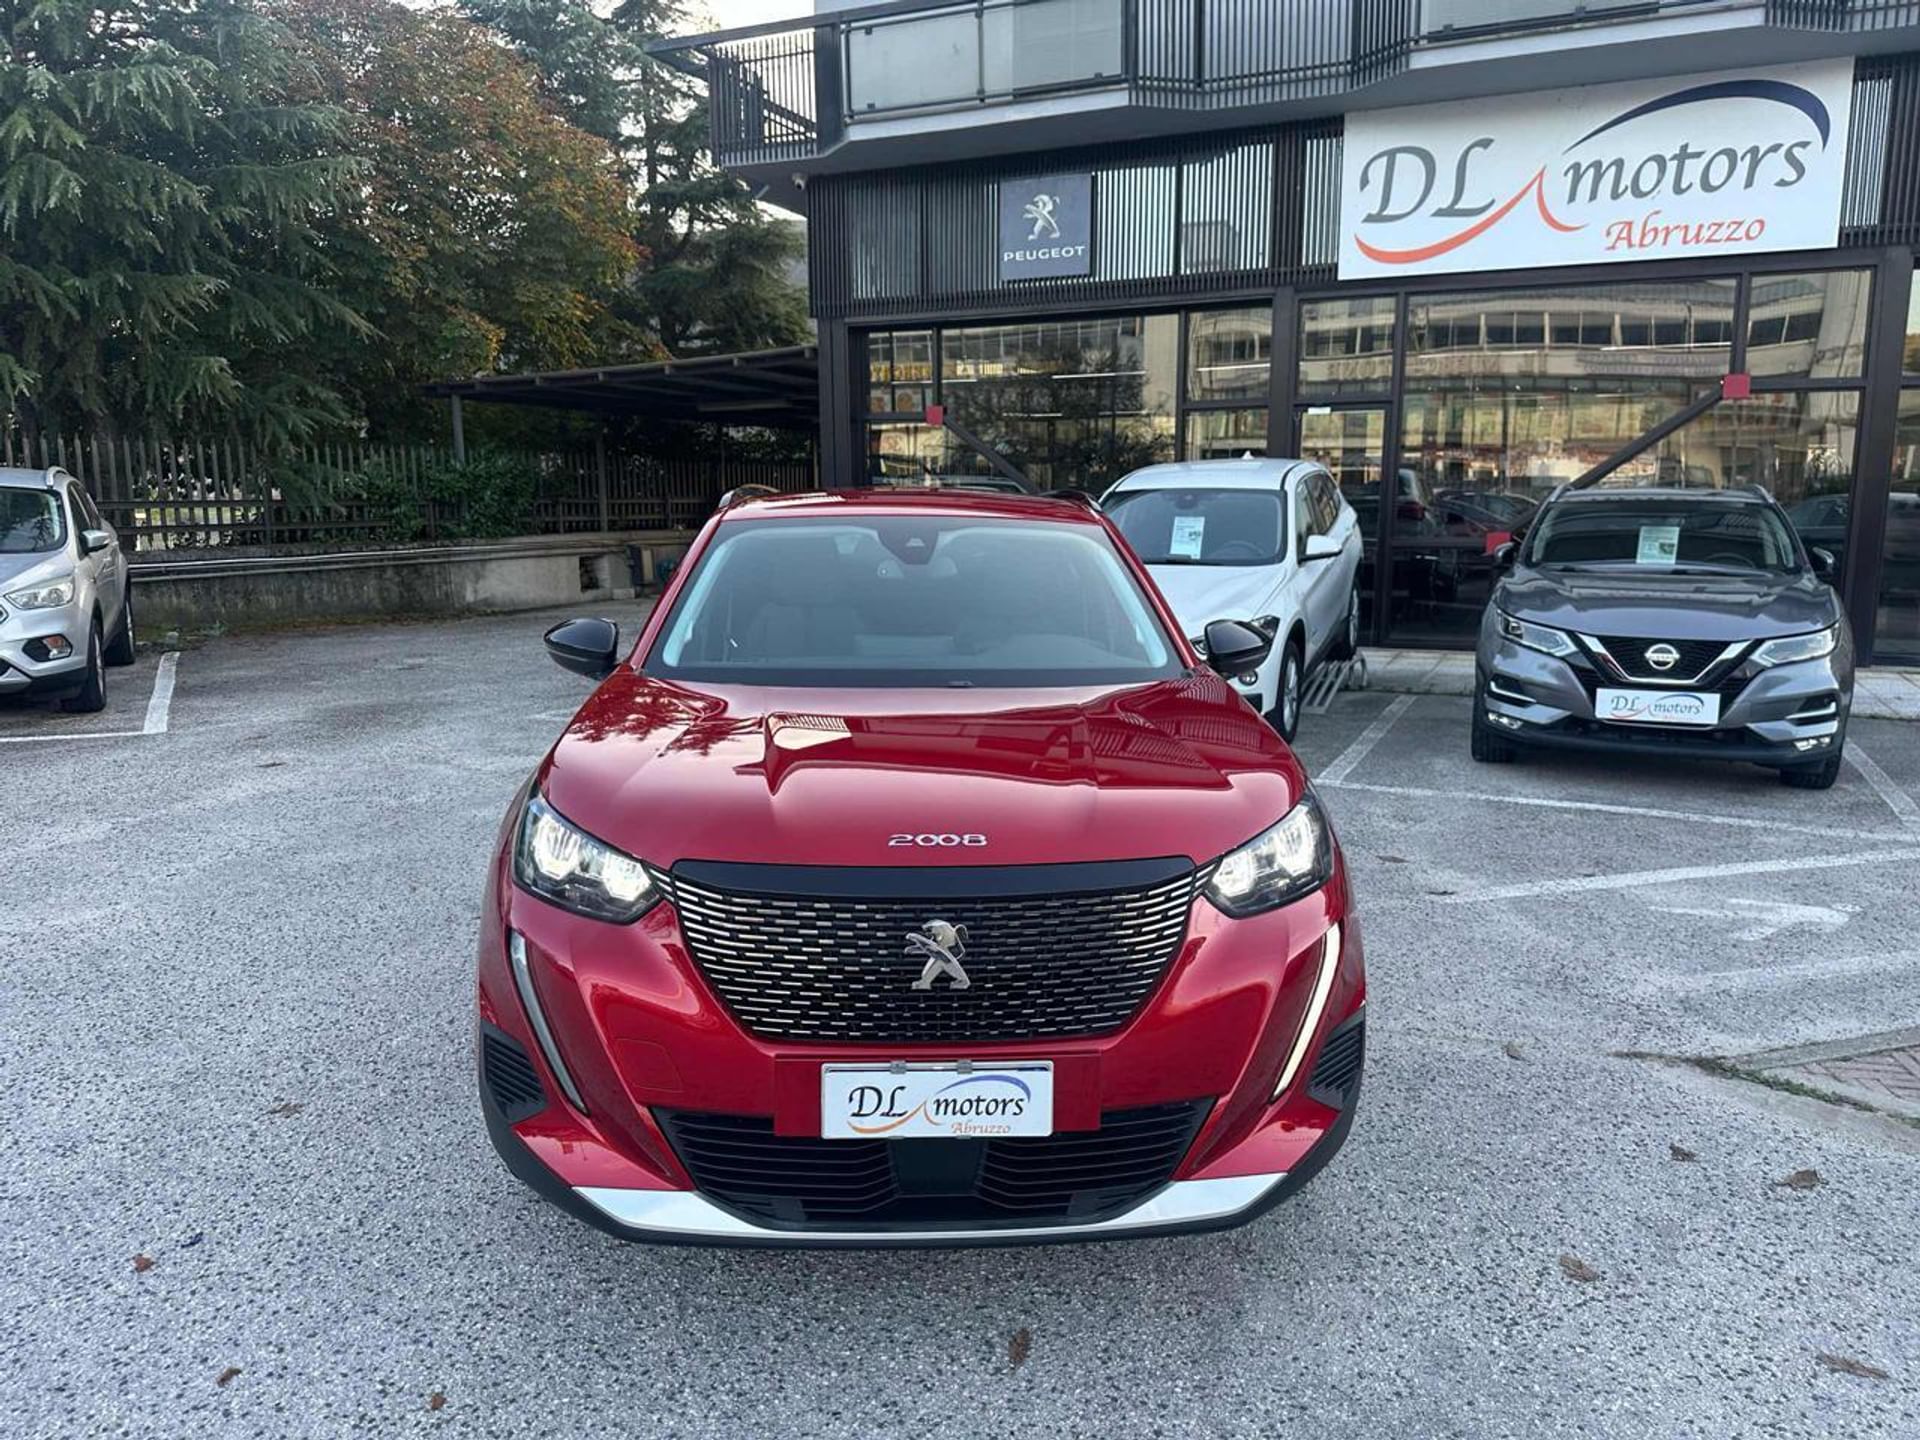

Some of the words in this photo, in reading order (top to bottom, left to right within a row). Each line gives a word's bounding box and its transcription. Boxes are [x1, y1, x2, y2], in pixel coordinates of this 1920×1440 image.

[1359, 137, 1495, 223] DL
[1563, 139, 1813, 204] motors
[1605, 210, 1765, 251] Abruzzo
[1003, 245, 1085, 262] PEUGEOT
[1610, 695, 1640, 711] DL
[1653, 701, 1701, 715] motors
[887, 833, 988, 846] 2008
[848, 1085, 908, 1117] DL
[933, 1092, 1025, 1116] motors
[951, 1121, 1011, 1134] Abruzzo
